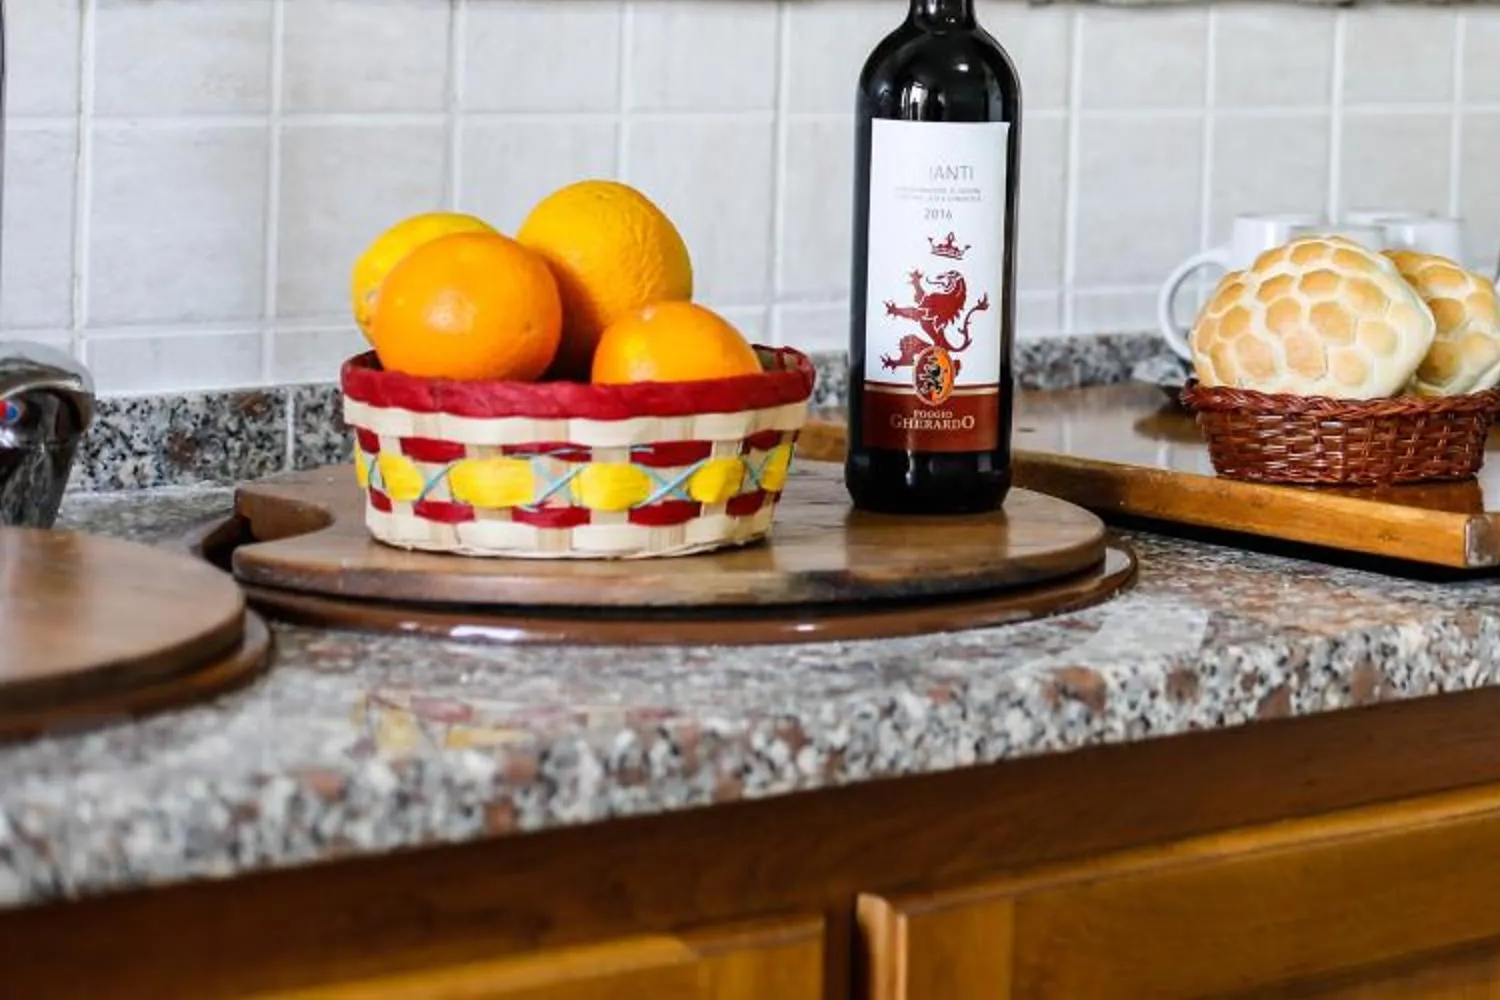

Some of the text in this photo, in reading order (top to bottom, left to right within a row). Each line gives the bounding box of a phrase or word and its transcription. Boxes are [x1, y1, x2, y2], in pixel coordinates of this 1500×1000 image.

[929, 164, 975, 181] IANTI
[889, 413, 975, 431] GHERARDO
[913, 409, 953, 419] POGGIO
